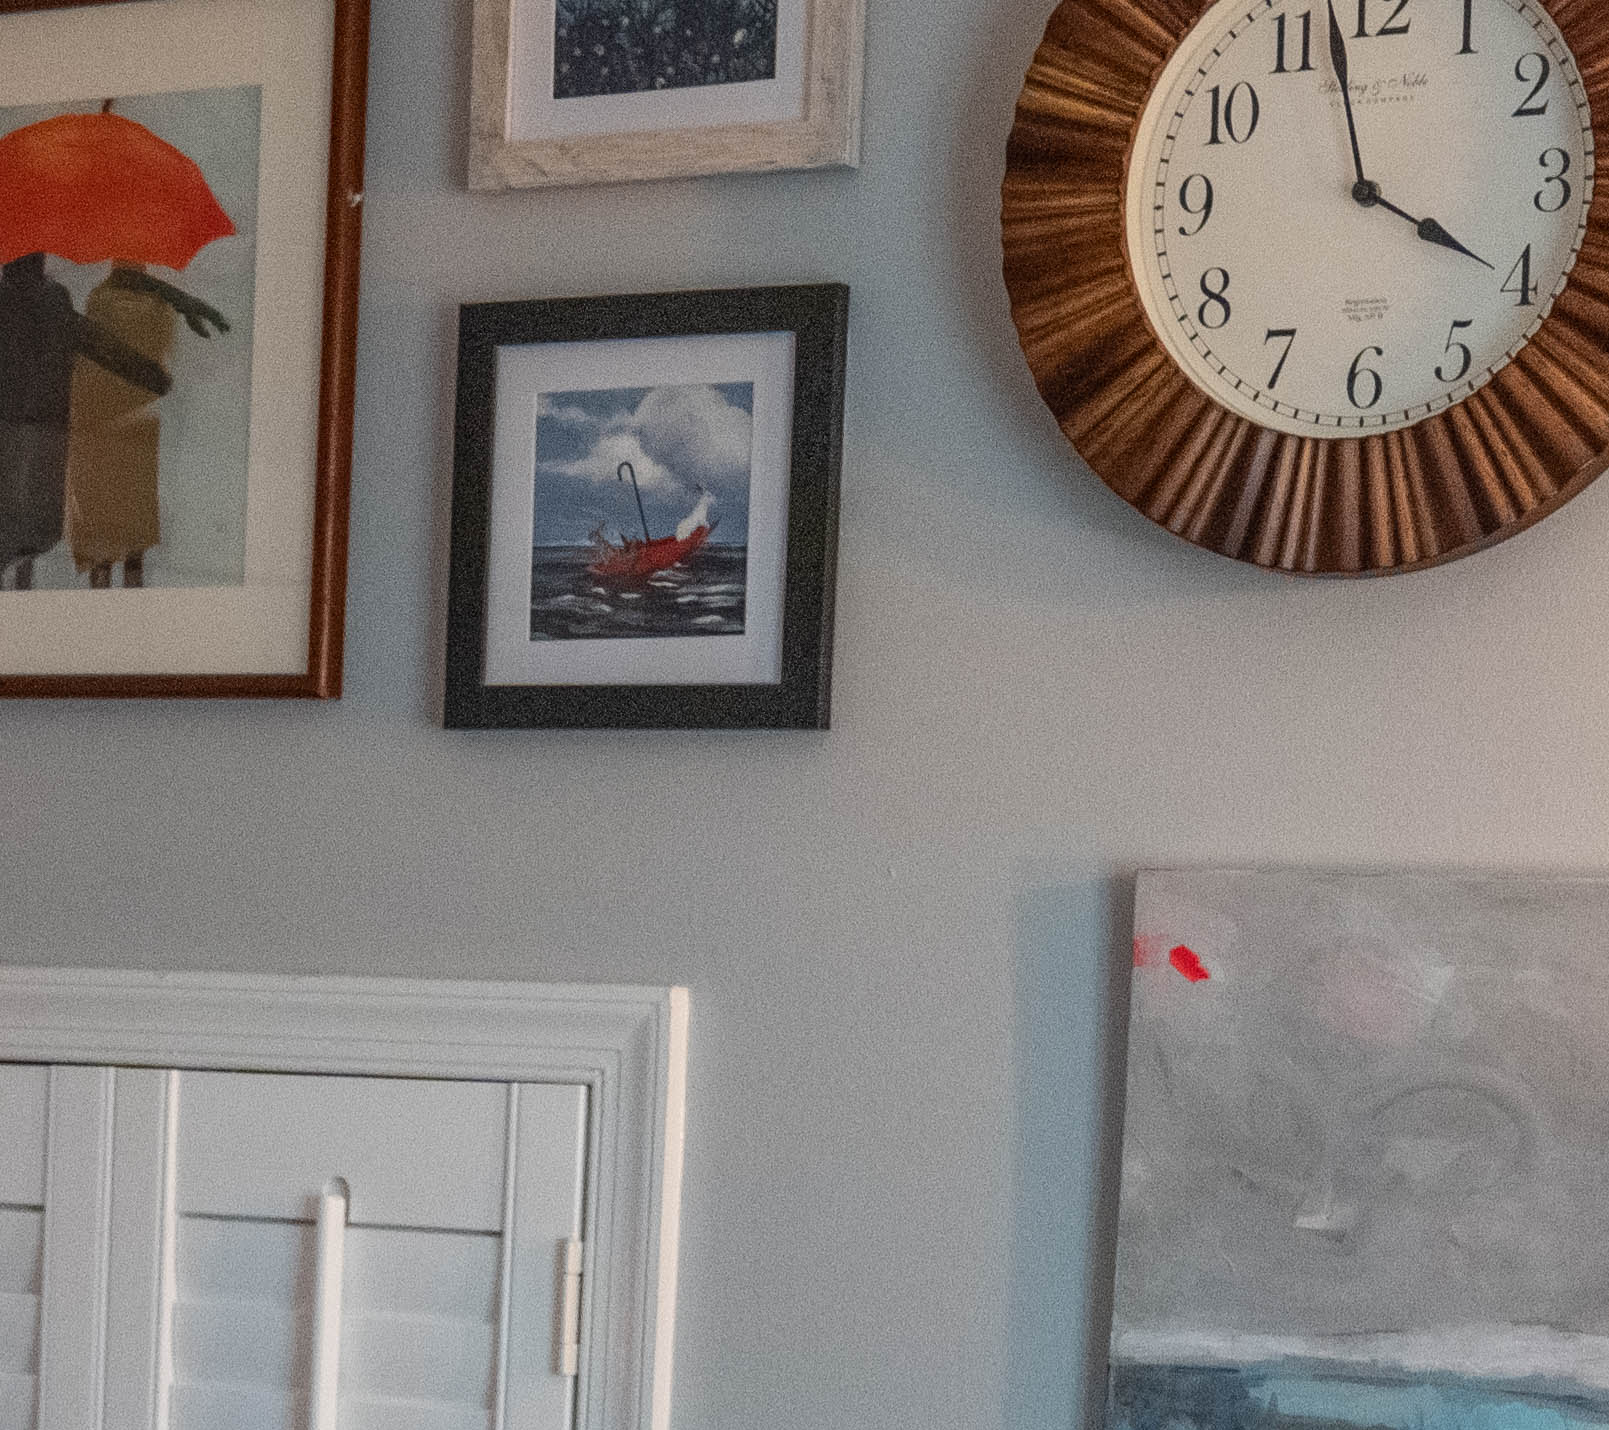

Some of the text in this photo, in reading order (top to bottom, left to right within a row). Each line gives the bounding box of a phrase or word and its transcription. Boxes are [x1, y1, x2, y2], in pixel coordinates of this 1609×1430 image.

[1269, 10, 1316, 74] 11
[1455, 0, 1478, 55] 1
[1203, 81, 1260, 146] 10
[1512, 52, 1550, 117] 2
[1178, 173, 1213, 236] 9
[1533, 147, 1572, 213] 3
[1198, 267, 1230, 329] 8
[1500, 243, 1537, 306] 4
[1263, 328, 1296, 390] 7
[1346, 346, 1383, 409] 6
[1434, 319, 1473, 383] 5
